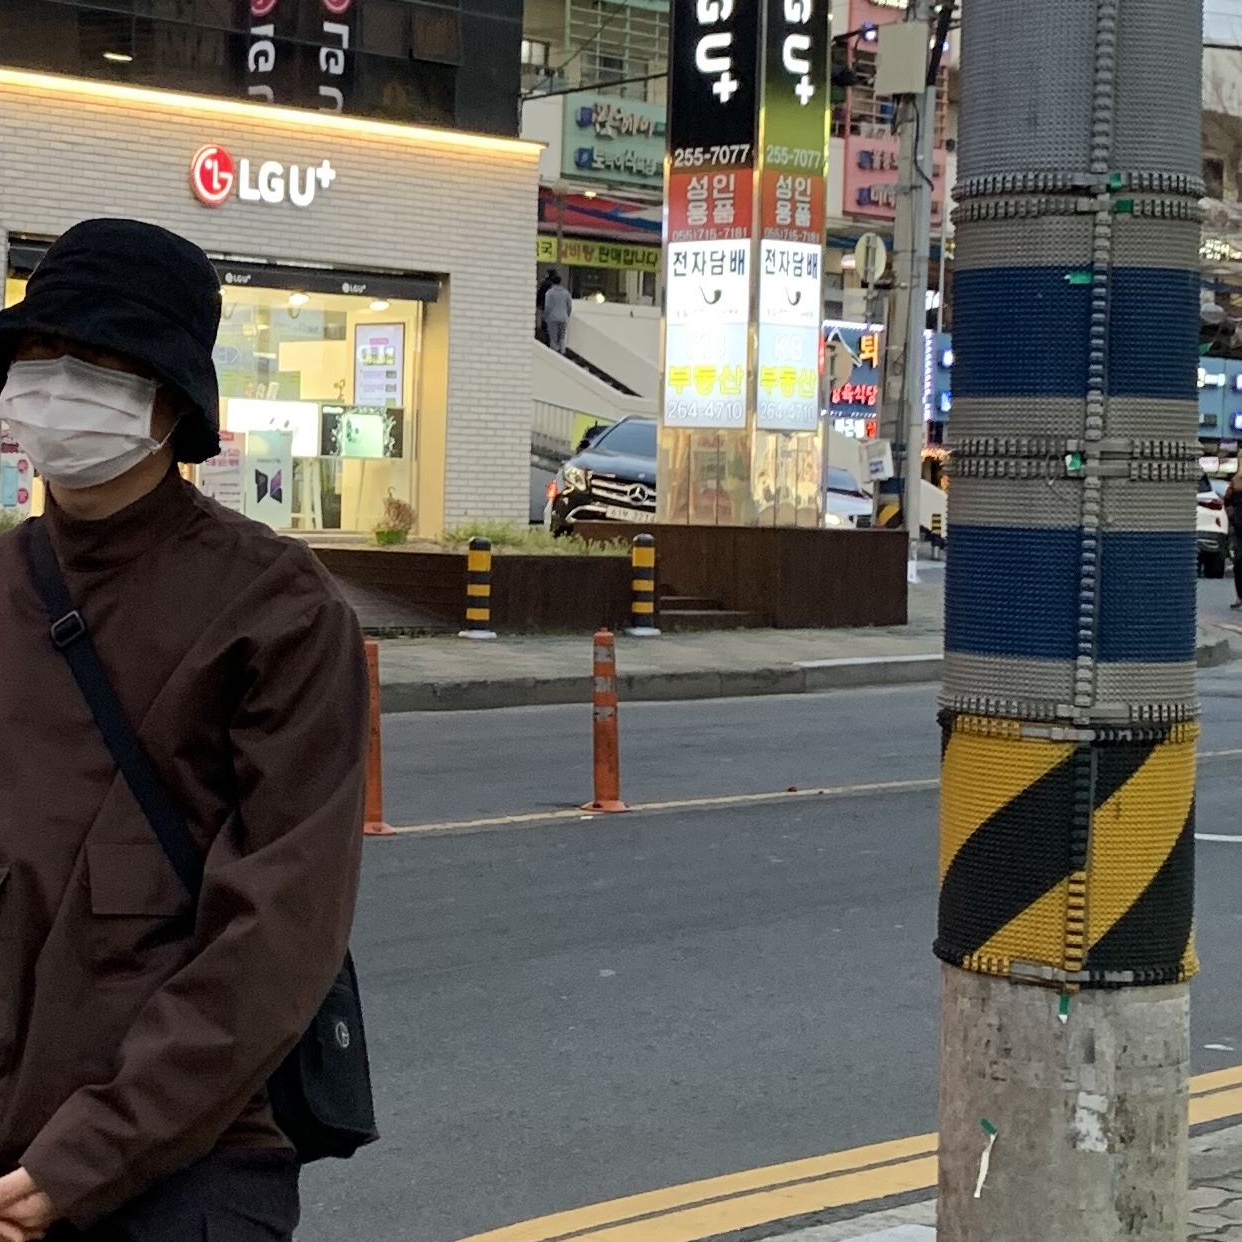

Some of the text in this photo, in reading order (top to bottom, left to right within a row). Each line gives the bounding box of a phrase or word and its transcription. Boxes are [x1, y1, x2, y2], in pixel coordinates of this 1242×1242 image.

[674, 144, 750, 168] 255-7077
[766, 144, 821, 169] 255-7077
[687, 174, 735, 200] 성인
[776, 174, 812, 201] 성인
[687, 199, 735, 226] 용품
[776, 199, 811, 227] 용품
[673, 249, 745, 277] 전자담배
[765, 249, 818, 279] 전자담배
[668, 364, 744, 396] 부동산
[760, 365, 816, 398] 부동산
[668, 402, 743, 421] 264-4710
[759, 402, 814, 421] 264-4710
